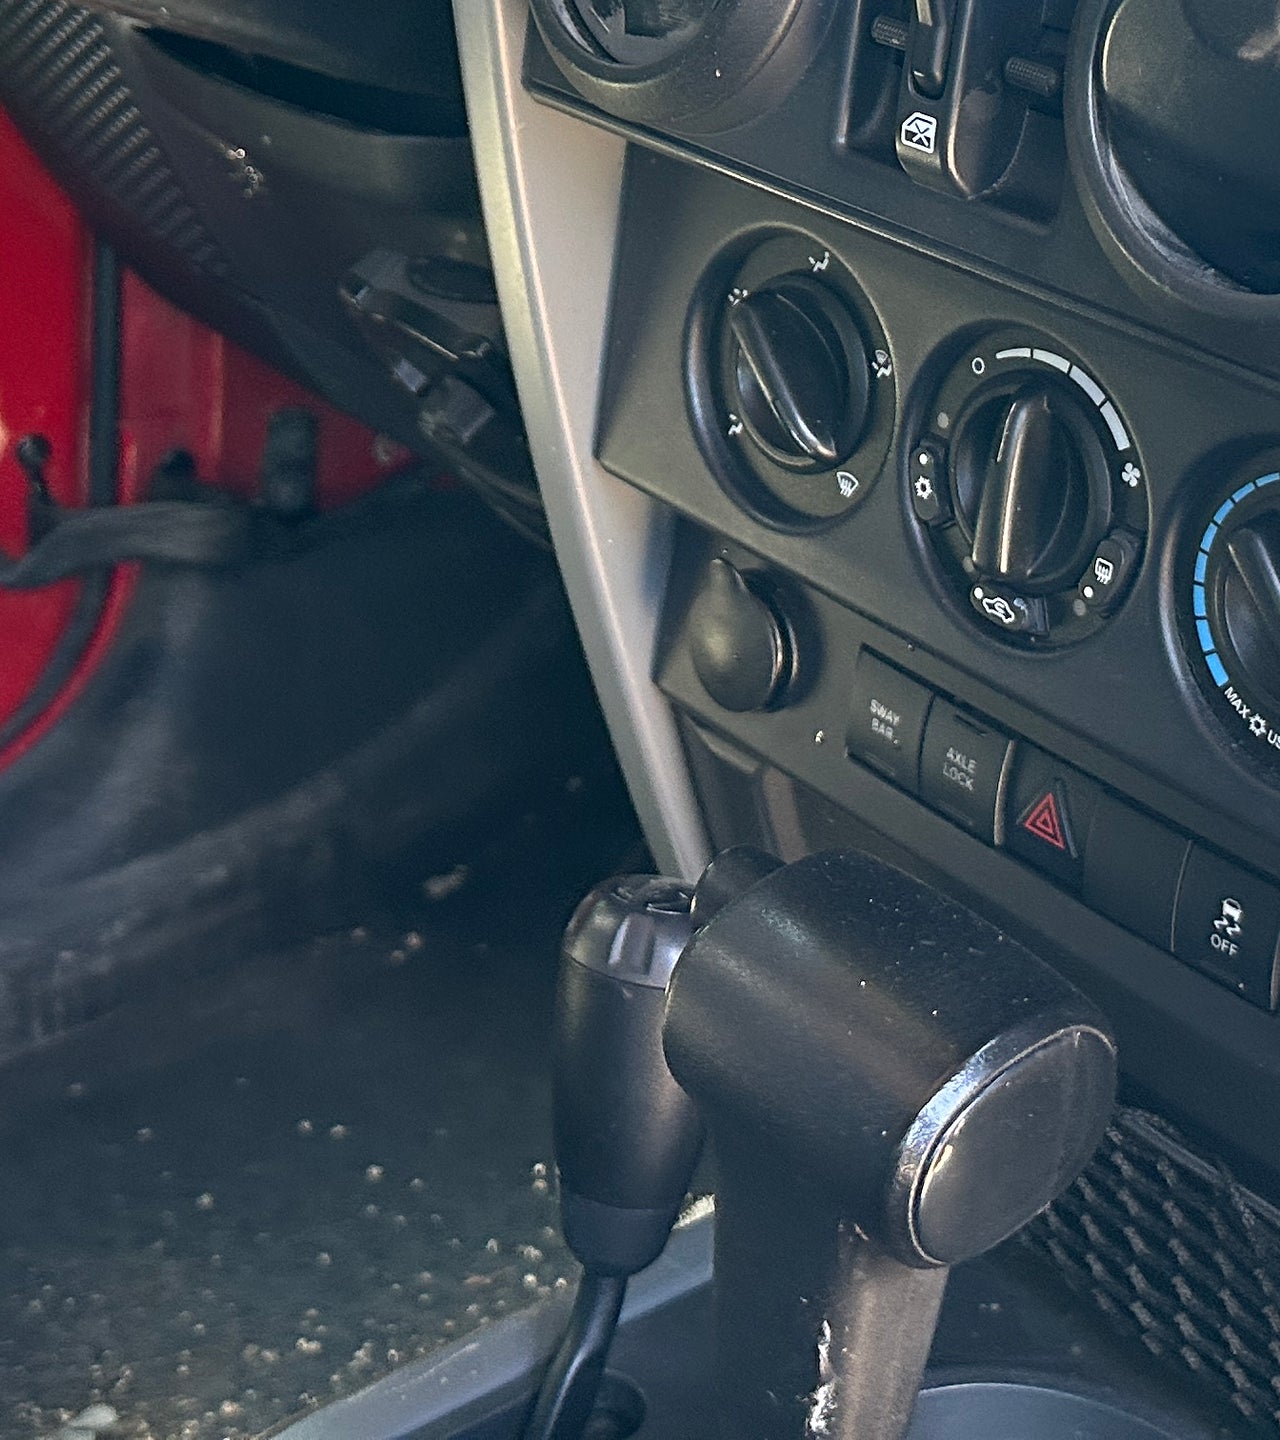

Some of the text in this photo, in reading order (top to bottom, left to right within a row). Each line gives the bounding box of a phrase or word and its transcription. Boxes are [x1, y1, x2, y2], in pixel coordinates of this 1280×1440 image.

[869, 698, 901, 727] SWAY
[1223, 686, 1251, 720] MAX
[871, 717, 894, 741] BAR
[946, 746, 978, 775] AXLE
[942, 761, 974, 792] LOCK
[1209, 932, 1239, 958] OFF
